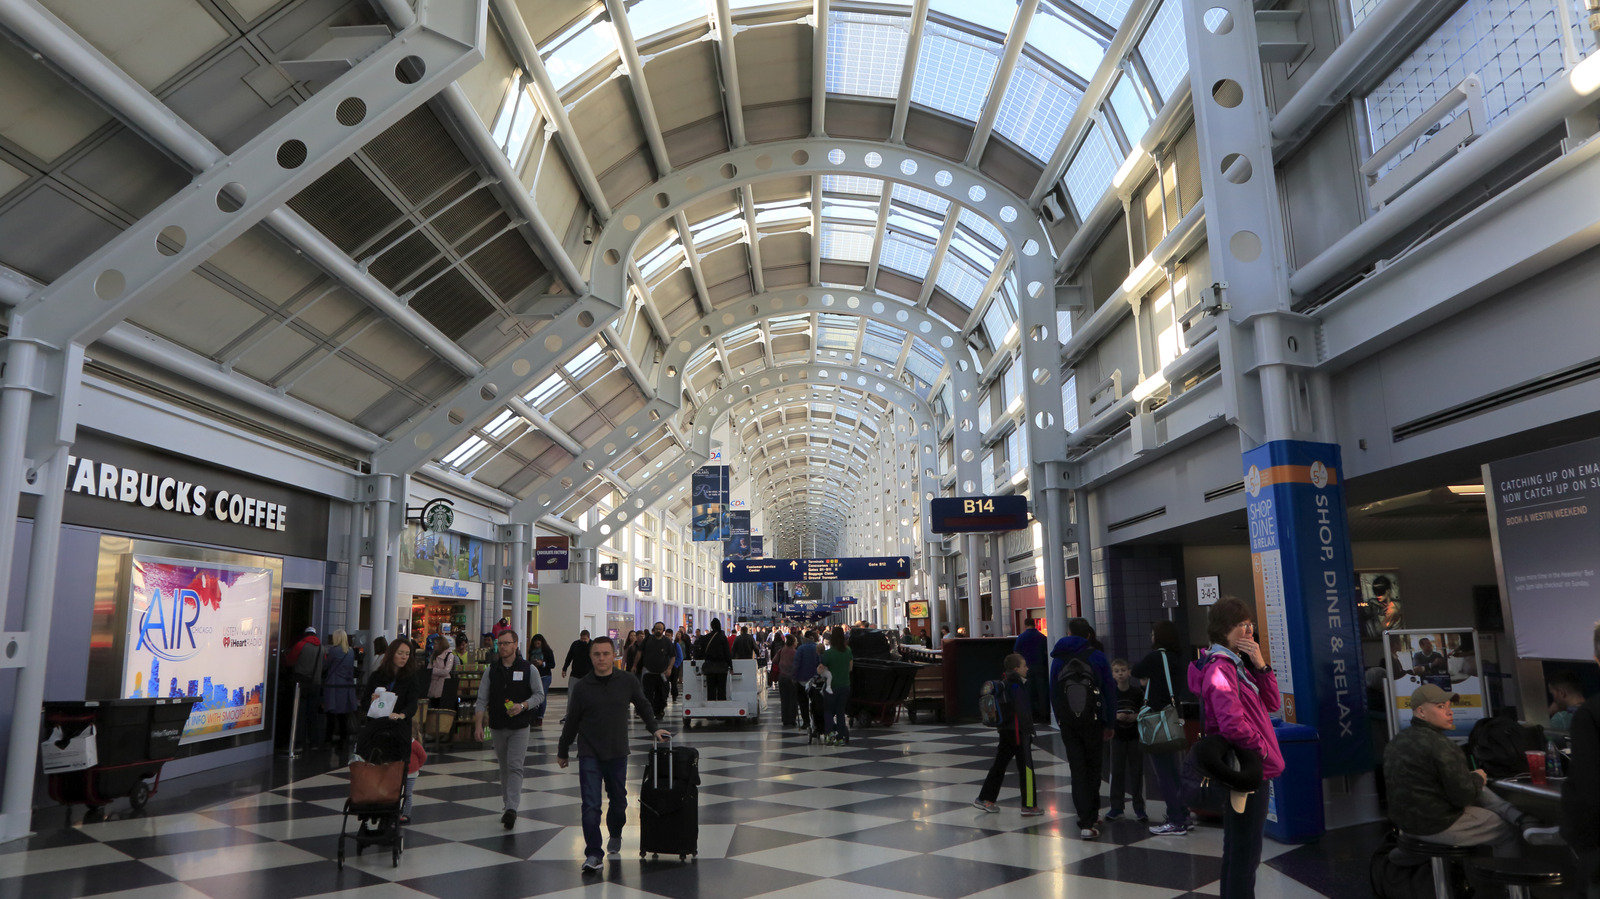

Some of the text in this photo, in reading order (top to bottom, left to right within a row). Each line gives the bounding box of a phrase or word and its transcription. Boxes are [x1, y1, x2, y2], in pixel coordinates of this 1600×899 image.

[1500, 462, 1600, 492] CATCHING UP ON EMA
[65, 455, 287, 532] TARBUCKS COFFEE
[1502, 492, 1521, 504] NOW
[1524, 486, 1553, 500] CATCH
[1556, 483, 1569, 494] UP
[1572, 480, 1587, 492] ON
[964, 499, 994, 514] B14
[1250, 499, 1272, 520] SHOP
[1506, 506, 1588, 526] BOOK A WESTIN WEEKEND
[1252, 517, 1275, 538] DINE
[880, 582, 895, 590] bar
[136, 588, 200, 650] AIR
[1316, 494, 1352, 738] SHOP, DINE & RELAX
[222, 627, 238, 636] LISTEN
[192, 714, 206, 726] INFO
[206, 713, 221, 724] WITH
[222, 709, 245, 721] SMOOTH
[246, 706, 259, 718] JAZZ
